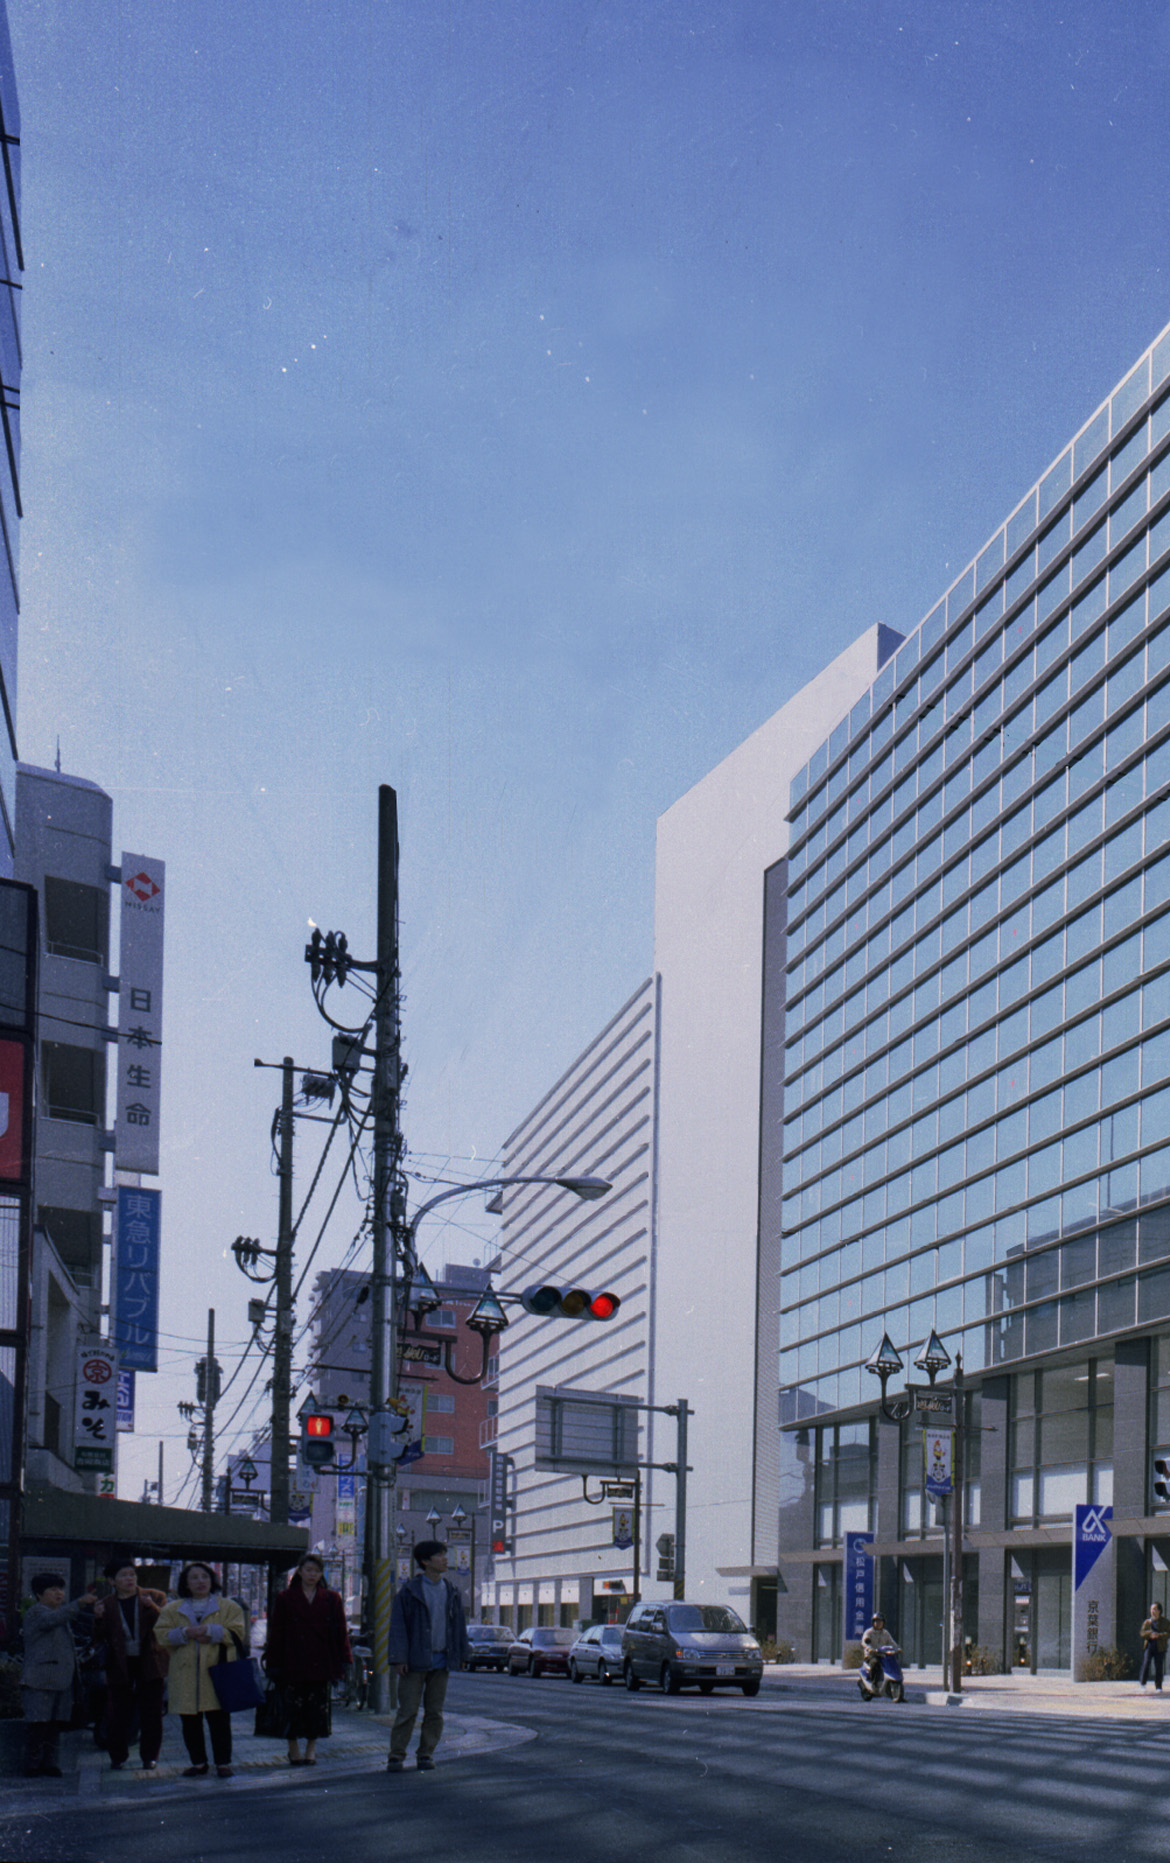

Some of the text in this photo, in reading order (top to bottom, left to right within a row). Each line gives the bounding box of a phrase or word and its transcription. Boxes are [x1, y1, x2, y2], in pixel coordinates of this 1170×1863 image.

[125, 901, 162, 913] NISSAY
[126, 987, 152, 1126] 日本生命
[125, 1194, 153, 1345] 東急リバブル
[82, 1390, 110, 1440] みそ
[493, 1521, 504, 1534] P
[1082, 1533, 1106, 1542] BANK
[1087, 1600, 1099, 1654] 京葉銀行
